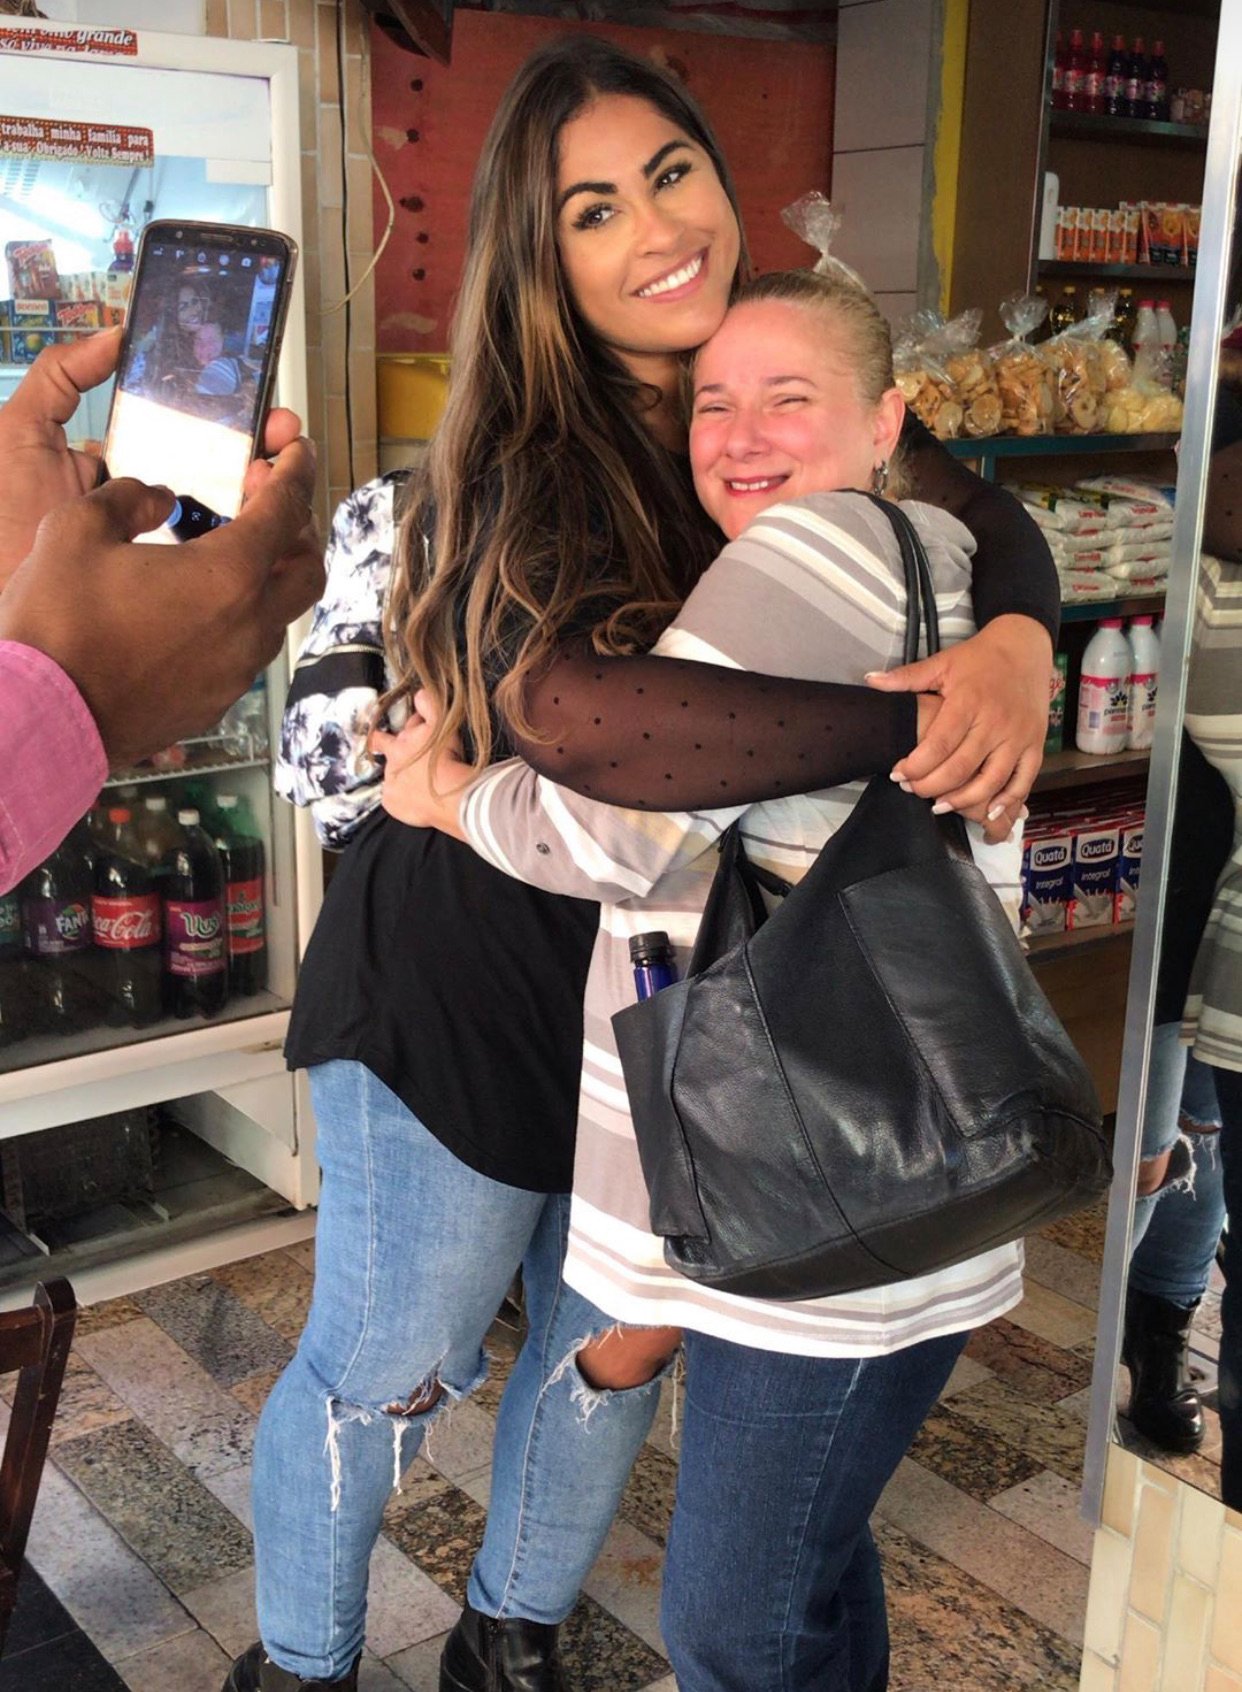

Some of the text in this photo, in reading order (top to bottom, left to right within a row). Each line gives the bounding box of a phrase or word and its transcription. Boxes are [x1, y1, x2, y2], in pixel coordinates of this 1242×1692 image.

[77, 30, 133, 46] grande
[2, 122, 44, 138] trabalha
[51, 126, 81, 141] minha
[127, 134, 149, 147] para
[1035, 845, 1066, 866] Quatá
[1081, 841, 1112, 858] Quatá
[55, 907, 90, 934] FANT
